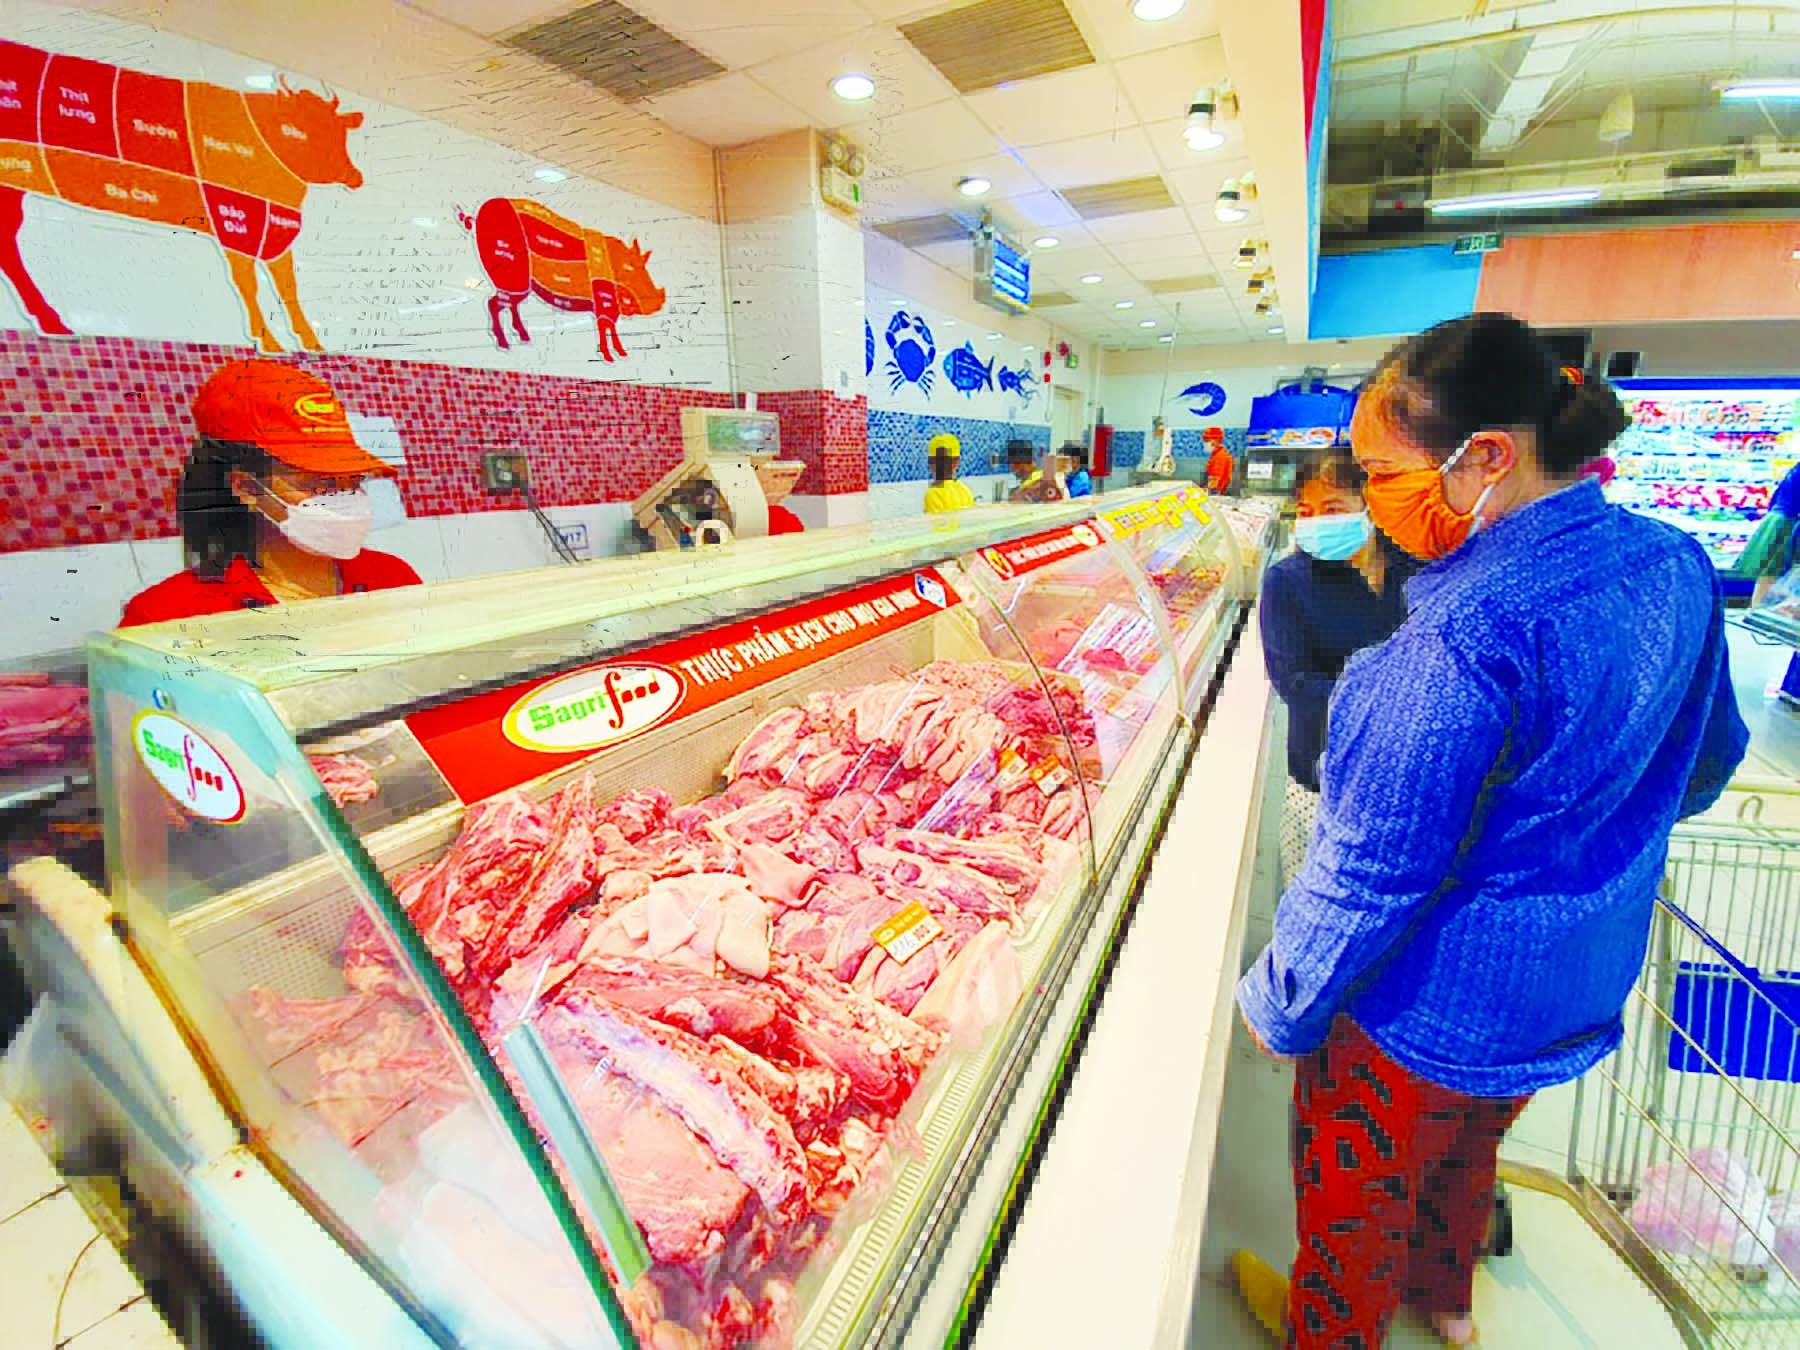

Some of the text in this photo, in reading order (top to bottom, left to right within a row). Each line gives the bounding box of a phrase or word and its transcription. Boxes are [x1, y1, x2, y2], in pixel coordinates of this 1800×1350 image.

[680, 647, 743, 686] THỰC
[735, 625, 793, 668] PHẨM
[785, 617, 831, 650] SẠCH
[823, 610, 857, 635] CHO
